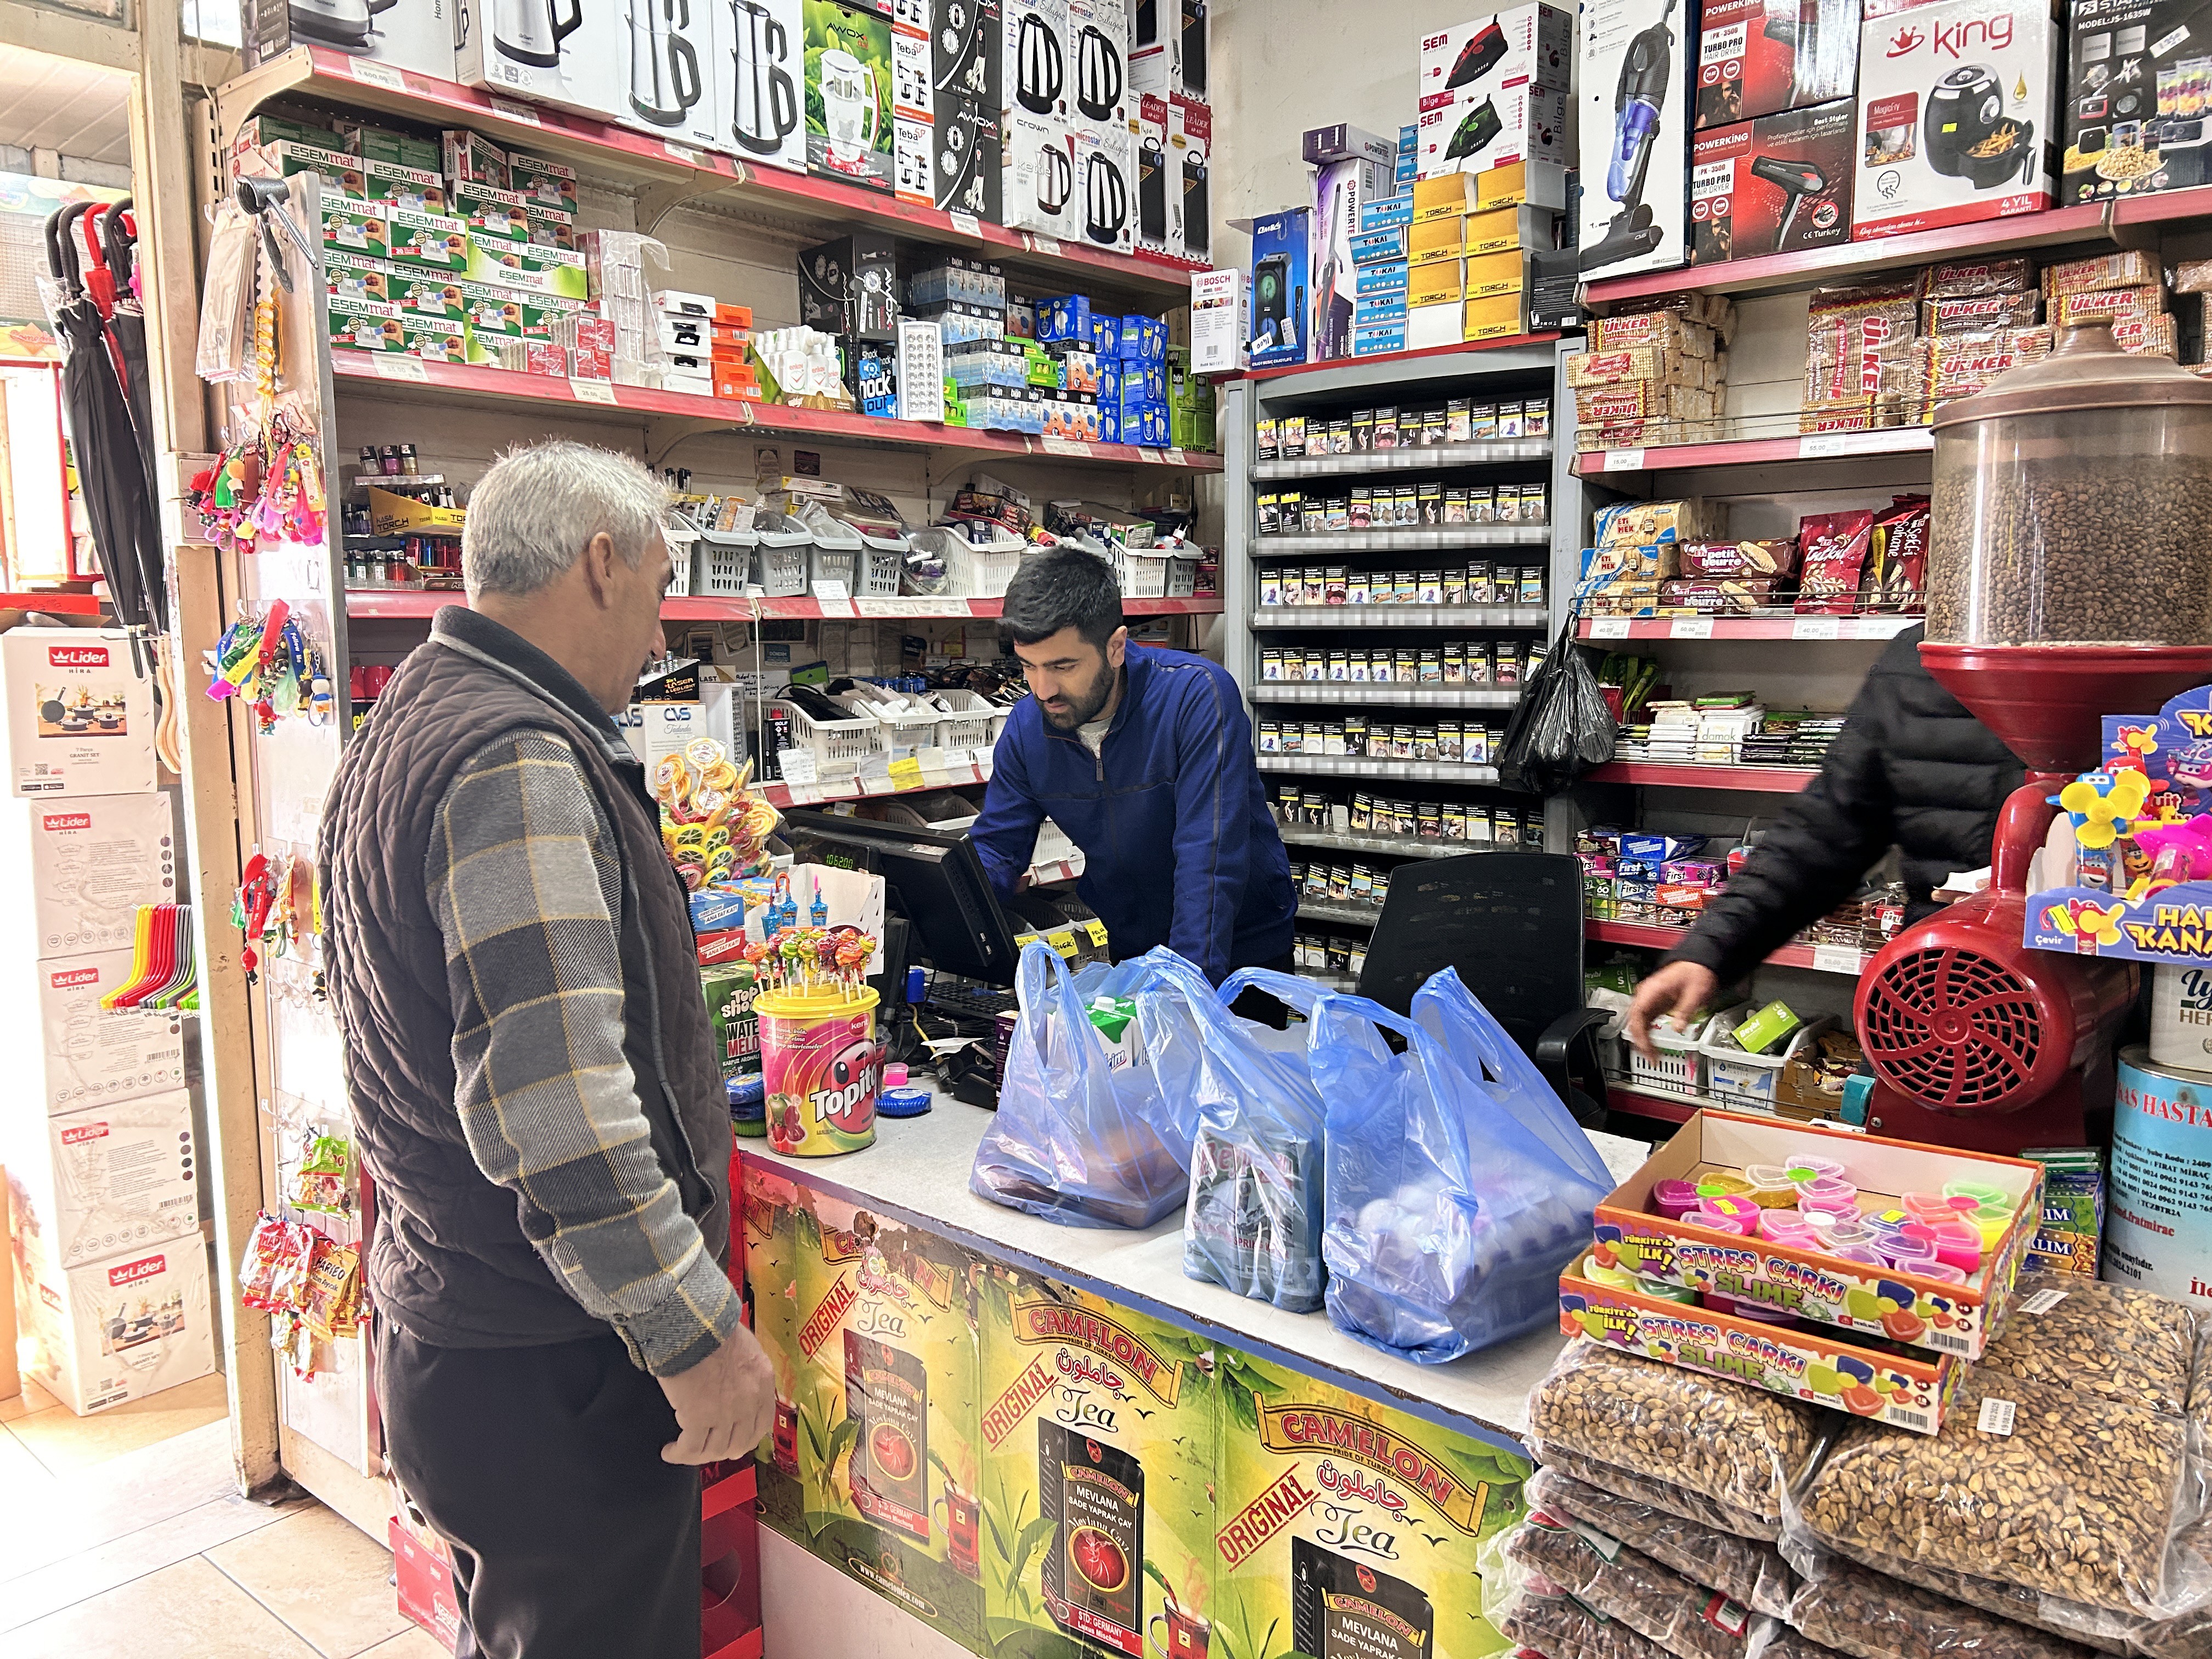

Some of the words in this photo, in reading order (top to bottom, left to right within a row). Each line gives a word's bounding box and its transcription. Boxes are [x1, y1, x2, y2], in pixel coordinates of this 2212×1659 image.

[827, 22, 865, 40] AWOX
[1934, 12, 2014, 58] king
[895, 42, 917, 56] Teba
[1423, 33, 1448, 51] SEM
[1705, 41, 1728, 54] TURBO
[1729, 37, 1743, 48] PRO
[1704, 50, 1719, 61] HAIR
[1720, 46, 1742, 57] DRYER
[1529, 85, 1545, 98] SEM
[1142, 99, 1166, 115] LEADER
[1422, 97, 1438, 108] Bilge
[957, 111, 995, 130] AWOX
[1186, 115, 1209, 130] LEADER
[1420, 111, 1443, 128] SEM
[1553, 96, 1564, 134] Bilge
[898, 127, 918, 141] Teba
[1017, 119, 1049, 134] crown
[290, 144, 355, 168] ESEMmat
[374, 164, 436, 185] ESEMmat
[518, 157, 569, 177] ESEMmat
[1692, 176, 1715, 189] TURBO
[1717, 173, 1731, 184] PRO
[1692, 186, 1707, 196] HAIR
[1709, 183, 1729, 194] DRYER
[464, 184, 520, 205] ESEMmat
[2001, 198, 2010, 208] 4
[2013, 196, 2033, 207] YIL
[321, 196, 377, 216] SEMmat
[2000, 205, 2032, 216] GARANTİ
[397, 212, 459, 232] ESEMmat
[1814, 227, 1841, 238] Turkey
[1421, 249, 1448, 259] TORCH
[394, 264, 454, 283] ESEMmat
[1204, 274, 1231, 286] BOSCH
[1938, 266, 1989, 281] ÜLKER
[1480, 282, 1509, 292] TORCH
[331, 298, 394, 317] ESEMmat
[1939, 300, 2001, 319] ÜLKER
[2069, 291, 2136, 313] ÜLKER
[1478, 325, 1506, 335] TORCH
[1604, 317, 1650, 334] ÜLKER
[1861, 316, 1891, 396] ÜLKE
[1593, 402, 1637, 417] ÜLKER
[1617, 524, 1634, 534] MEK
[1701, 556, 1742, 567] beurre
[1708, 549, 1736, 560] petit
[1601, 562, 1616, 571] MEK
[70, 651, 106, 664] Lider
[667, 678, 694, 689] LASER
[664, 707, 692, 721] CVS
[1702, 727, 1736, 742] damak
[61, 815, 88, 828] Lider
[1619, 862, 1645, 872] First
[1666, 870, 1687, 881] First
[1621, 883, 1643, 894] First
[2035, 935, 2063, 946] Çevir
[69, 971, 96, 985] Lider
[730, 986, 758, 1003] Top
[726, 1018, 759, 1040] WATE
[851, 1019, 869, 1030] kent
[727, 1035, 760, 1057] MELO
[2154, 1160, 2177, 1172] FIRAT
[1677, 1245, 1757, 1274] STRES
[127, 1259, 165, 1280] Lider
[1714, 1271, 1805, 1313] SLIME
[799, 1280, 855, 1356] ORIGINAL
[853, 1297, 906, 1338] Tea
[1639, 1317, 1718, 1346] STRES
[1030, 1309, 1158, 1384] CAMELON
[1677, 1342, 1766, 1384] SLIME
[874, 1387, 907, 1408] MEVLANA
[981, 1362, 1054, 1444] ORIGINAL
[1051, 1384, 1119, 1433] Tea
[1282, 1414, 1454, 1506] CAMELON
[1333, 1448, 1353, 1459] PRIDE
[1366, 1459, 1396, 1477] TURKEY
[1070, 1467, 1130, 1499] CAMELON
[1076, 1485, 1119, 1513] MEVLANA
[890, 1503, 914, 1521] GERMANY
[1068, 1496, 1088, 1510] SADE
[1088, 1503, 1117, 1523] YAPRAK
[1119, 1516, 1132, 1530] ÇAY
[1218, 1474, 1315, 1564] ORIGINAL
[1310, 1500, 1400, 1560] Tea
[1334, 1596, 1414, 1637] CAMELON
[1092, 1616, 1123, 1638] GERMANY
[1341, 1616, 1399, 1651] MEVLANA
[1096, 1627, 1124, 1648] Mischung
[1331, 1628, 1357, 1647] SADE
[1357, 1639, 1396, 1659] YAPRAK
